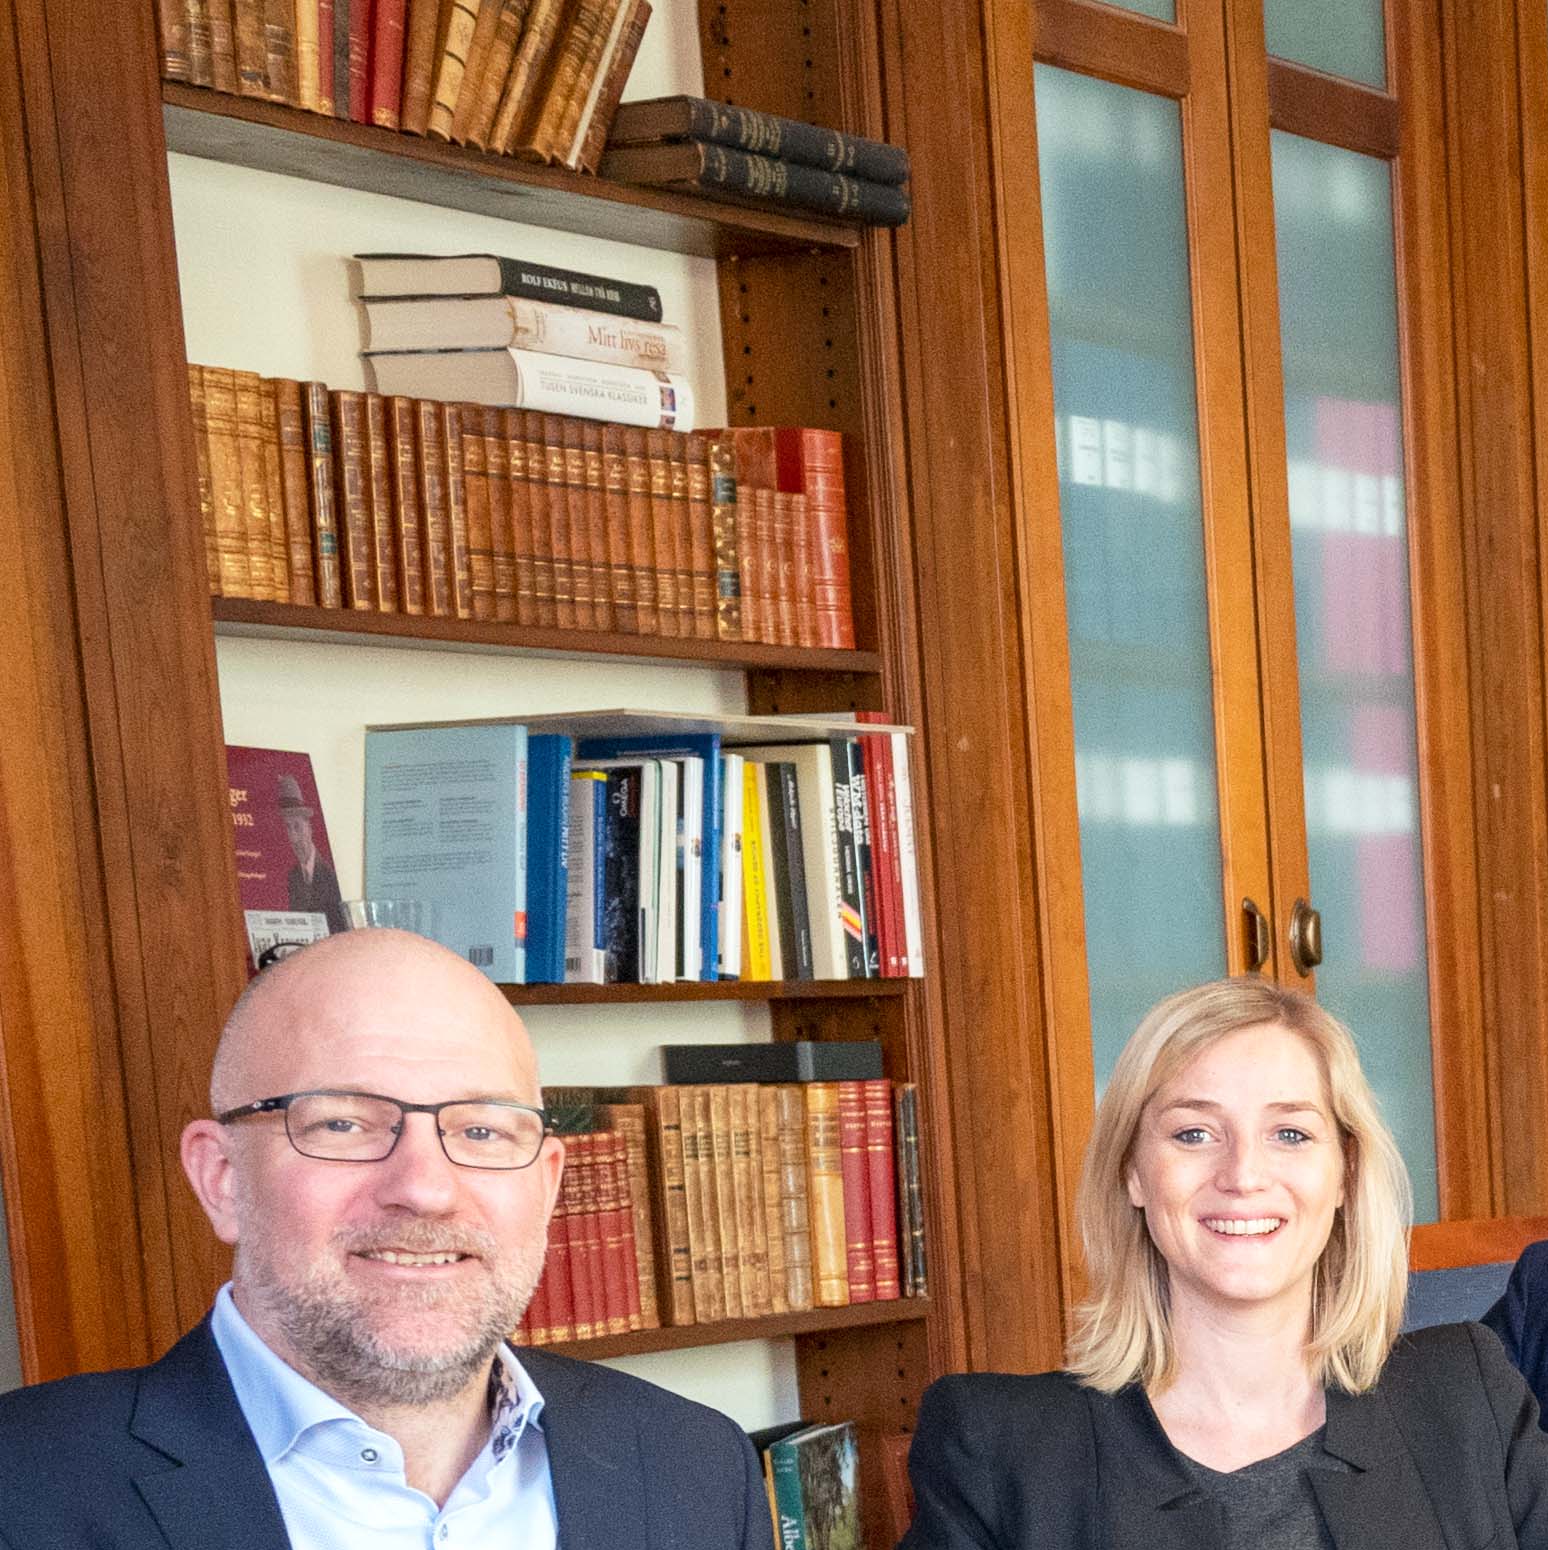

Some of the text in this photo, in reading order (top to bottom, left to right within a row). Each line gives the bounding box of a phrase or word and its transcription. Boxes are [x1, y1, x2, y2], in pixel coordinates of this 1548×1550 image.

[521, 272, 542, 288] ROLF
[587, 325, 667, 357] Mitt livs resa
[539, 379, 567, 394] TUSEN
[568, 383, 605, 399] SVENSKA
[606, 390, 648, 405] KLASSIKER
[232, 812, 255, 827] 1932
